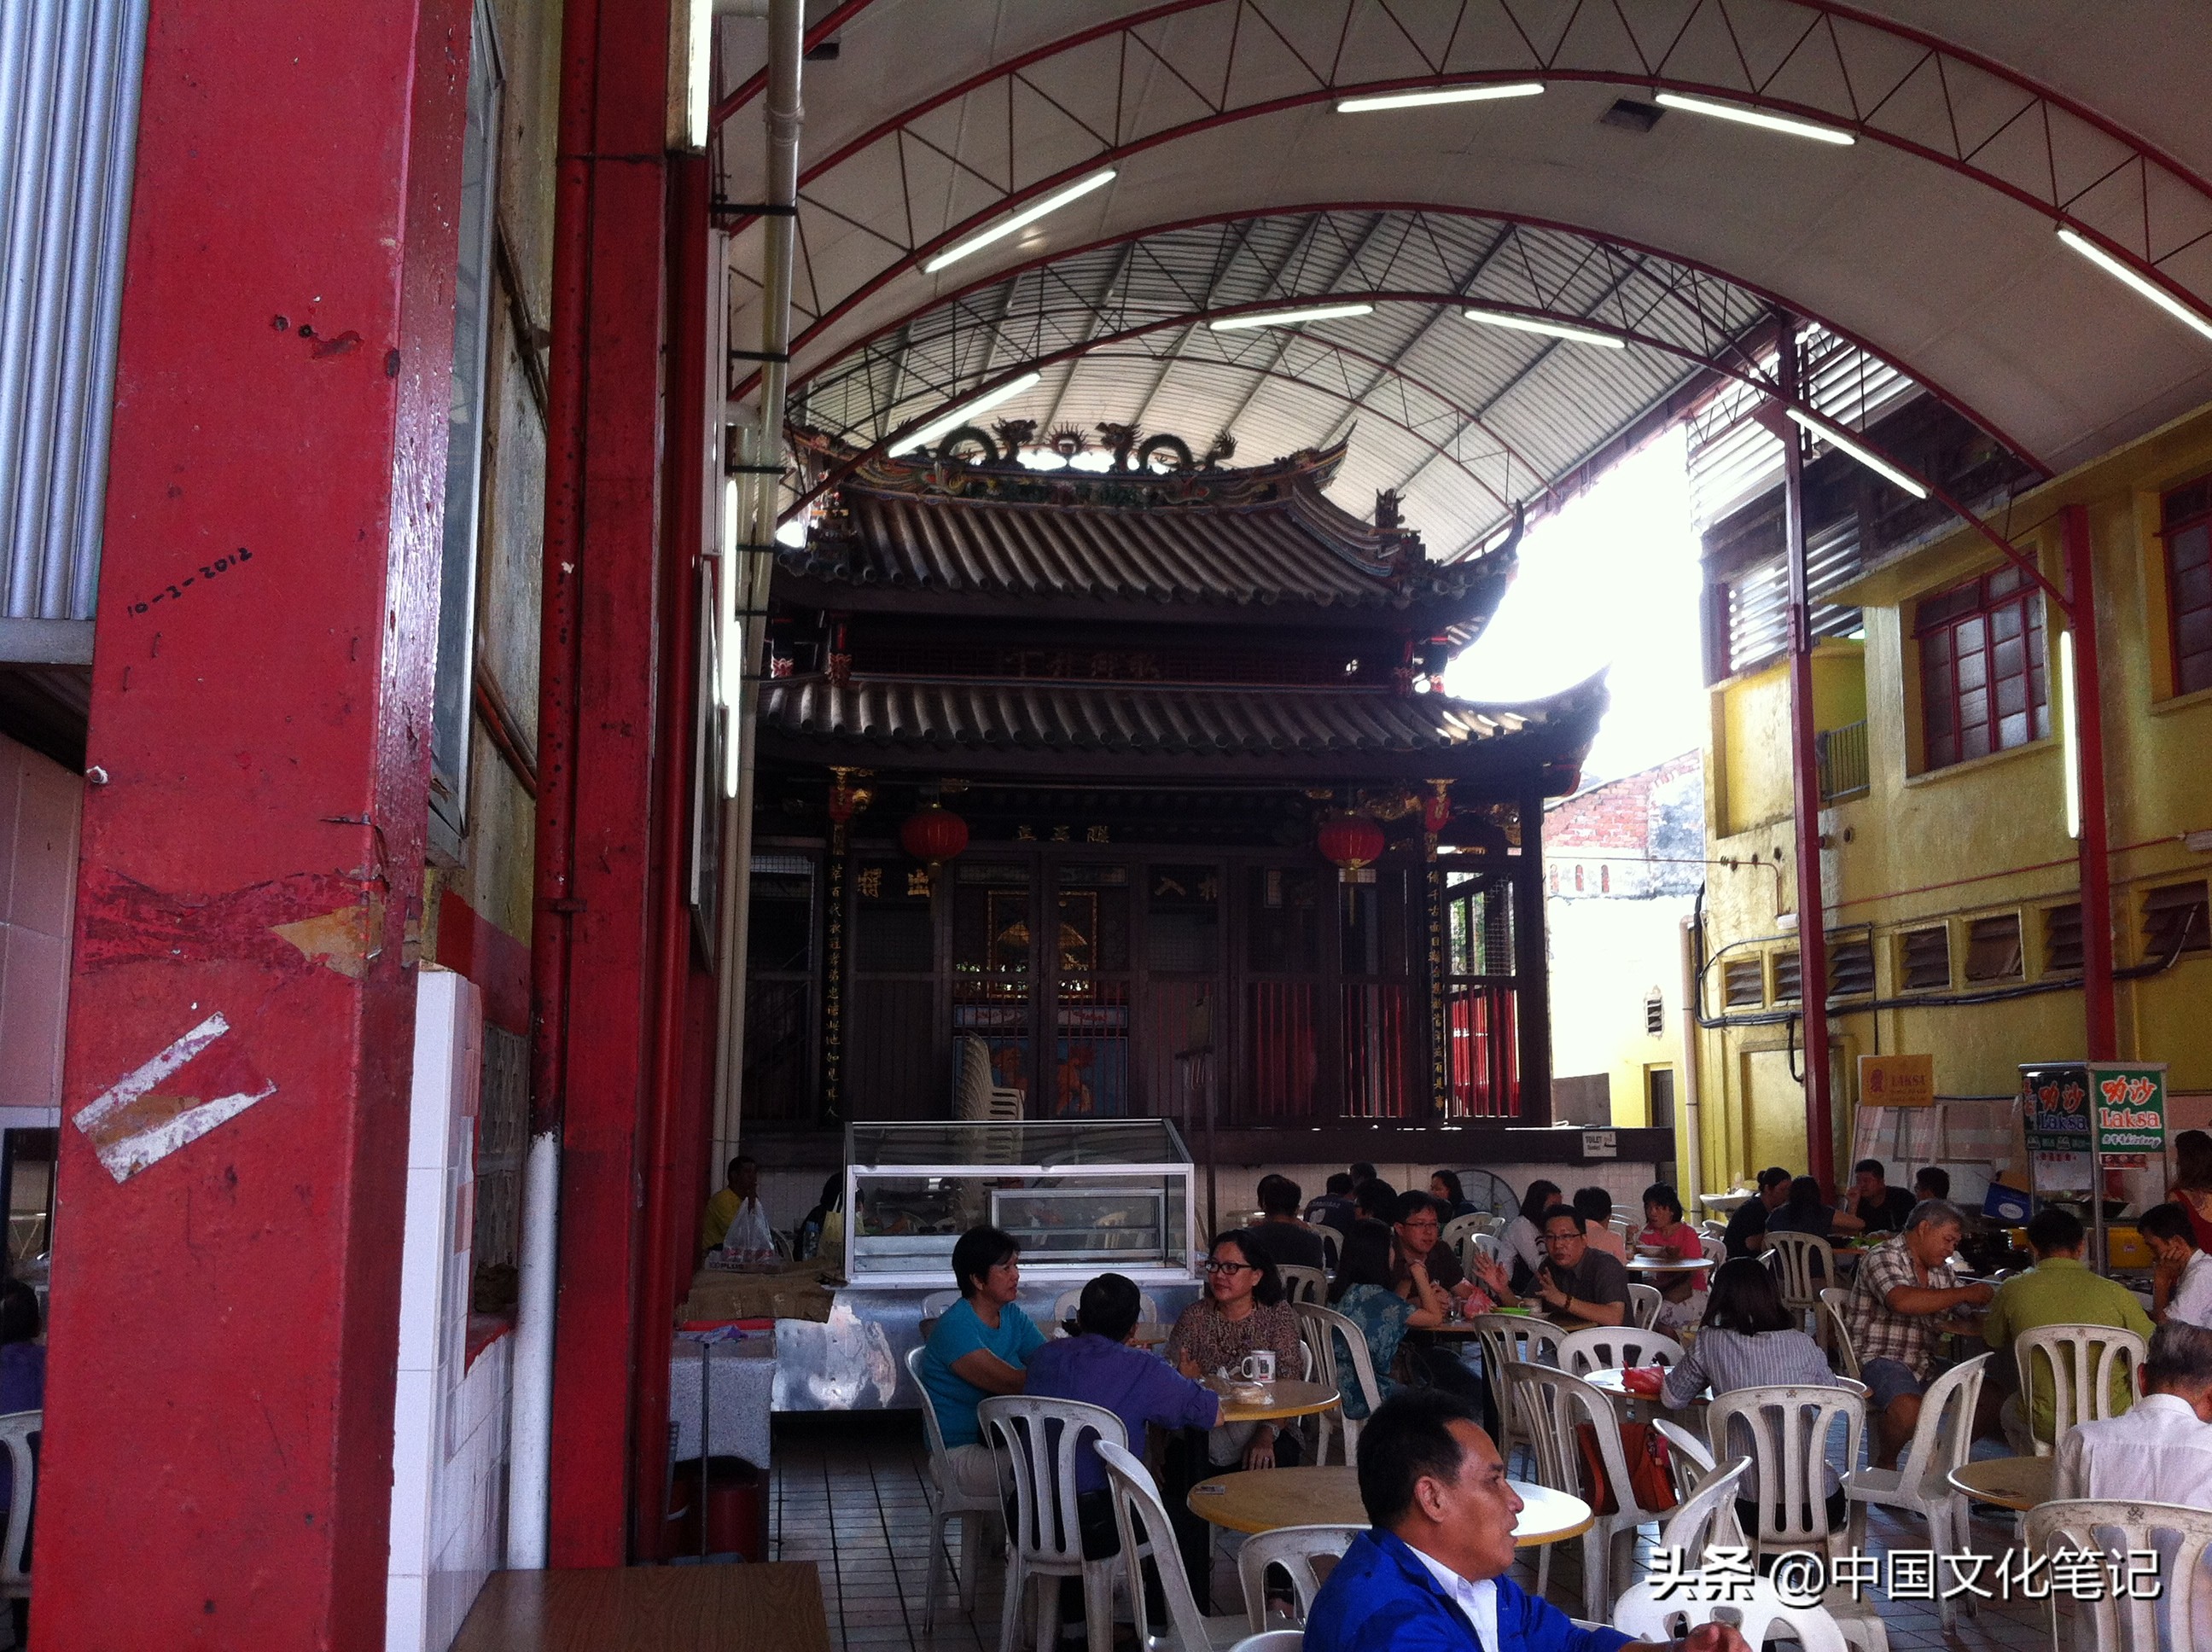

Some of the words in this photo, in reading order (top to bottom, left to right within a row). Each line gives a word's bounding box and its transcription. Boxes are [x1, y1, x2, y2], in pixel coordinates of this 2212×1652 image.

[2038, 1080, 2085, 1114] 叻沙
[2101, 1075, 2157, 1106] 叻沙
[2038, 1111, 2089, 1131] Laksa
[2100, 1108, 2162, 1129] Laksa
